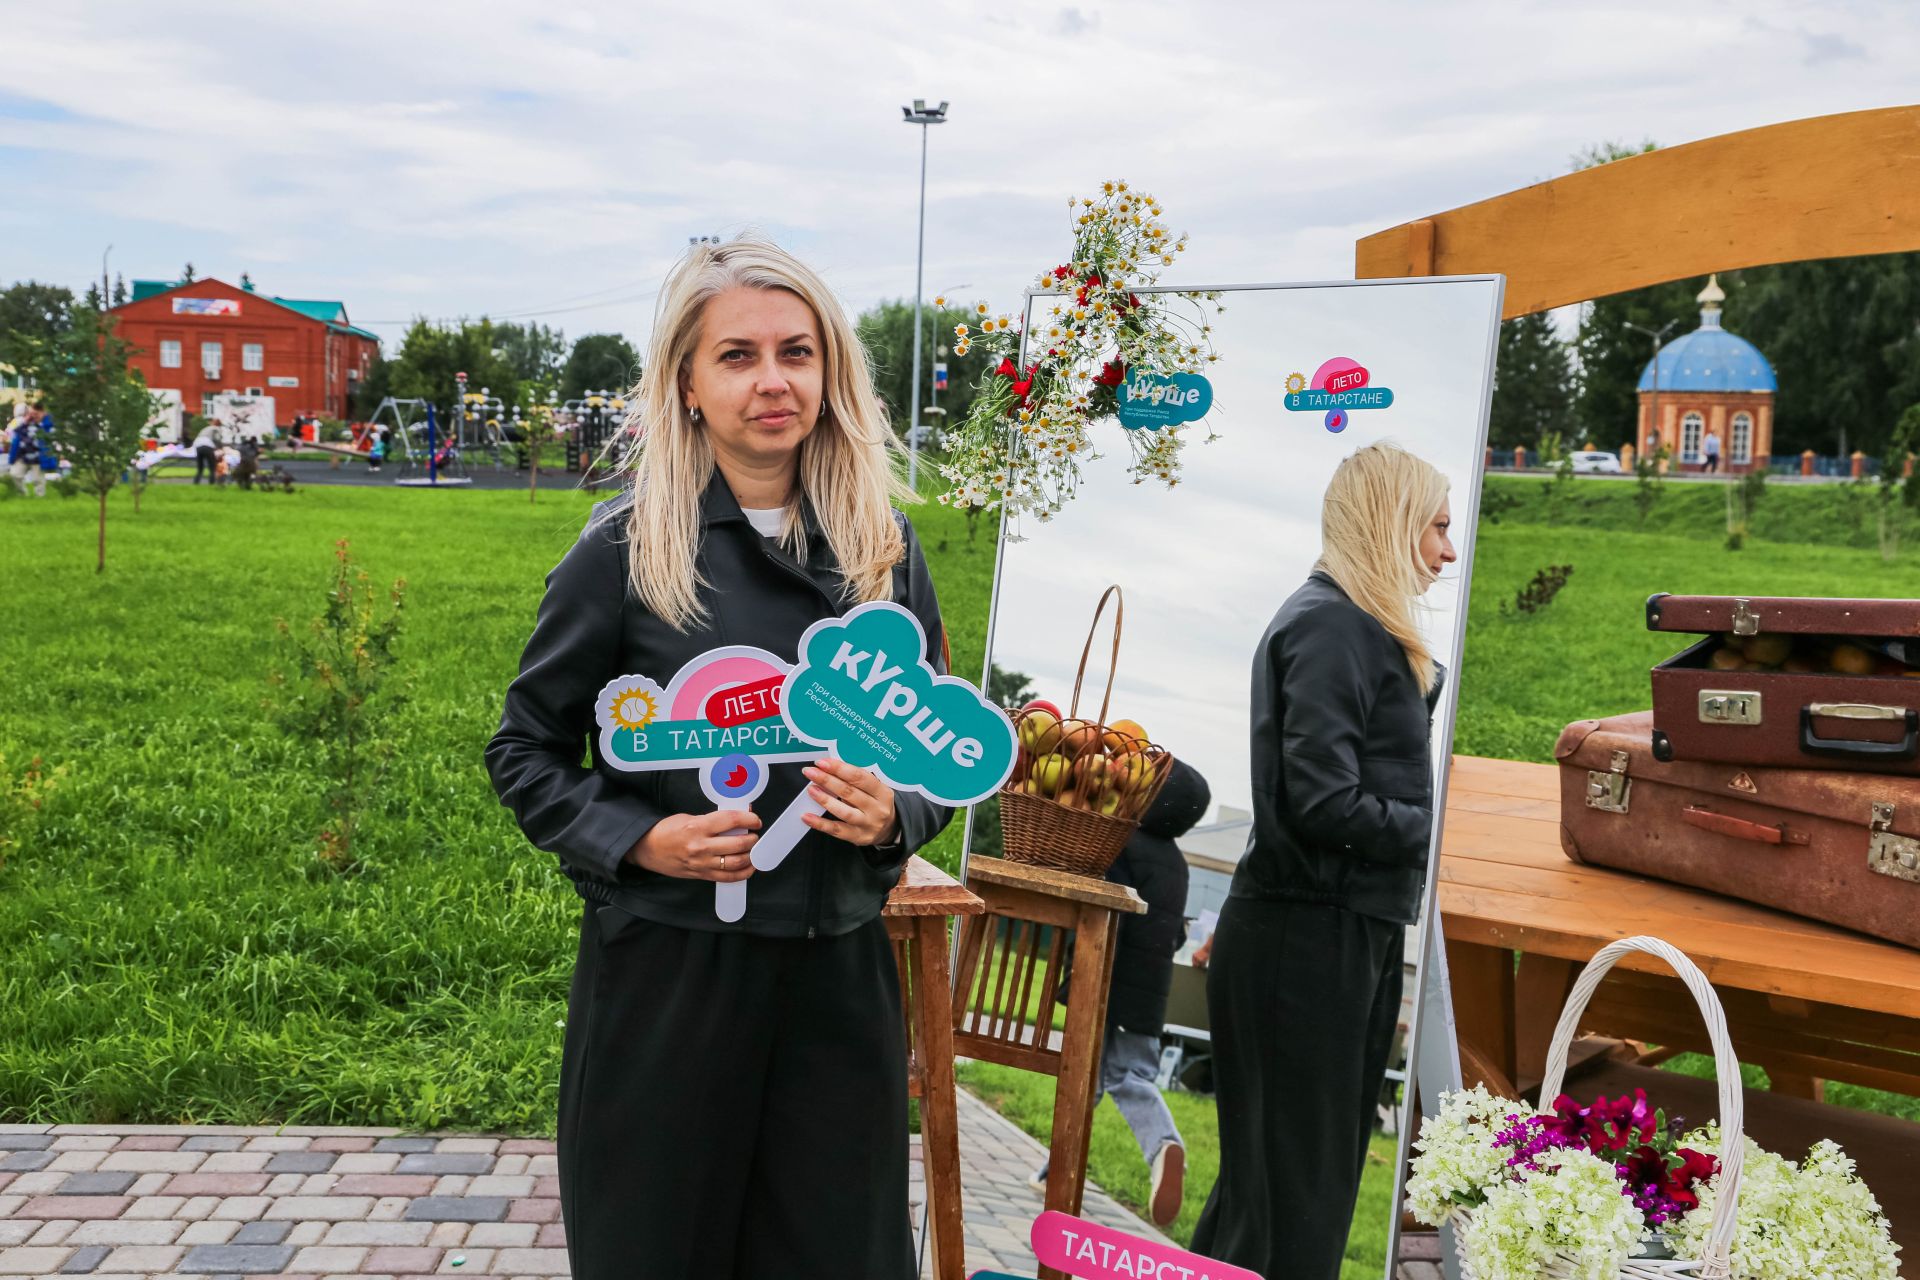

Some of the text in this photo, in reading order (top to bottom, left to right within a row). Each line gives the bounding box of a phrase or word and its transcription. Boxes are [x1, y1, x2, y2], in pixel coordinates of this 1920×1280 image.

[1332, 372, 1362, 390] ЛЕТО
[1292, 392, 1384, 407] В ТАТАРСТАНЕ
[723, 685, 782, 719] ЛЕТО
[811, 681, 902, 753] при поддержке Раиса
[805, 688, 898, 762] Республики Татарстан
[633, 732, 649, 753] В
[1061, 1229, 1212, 1280] ТАТАРСТ
